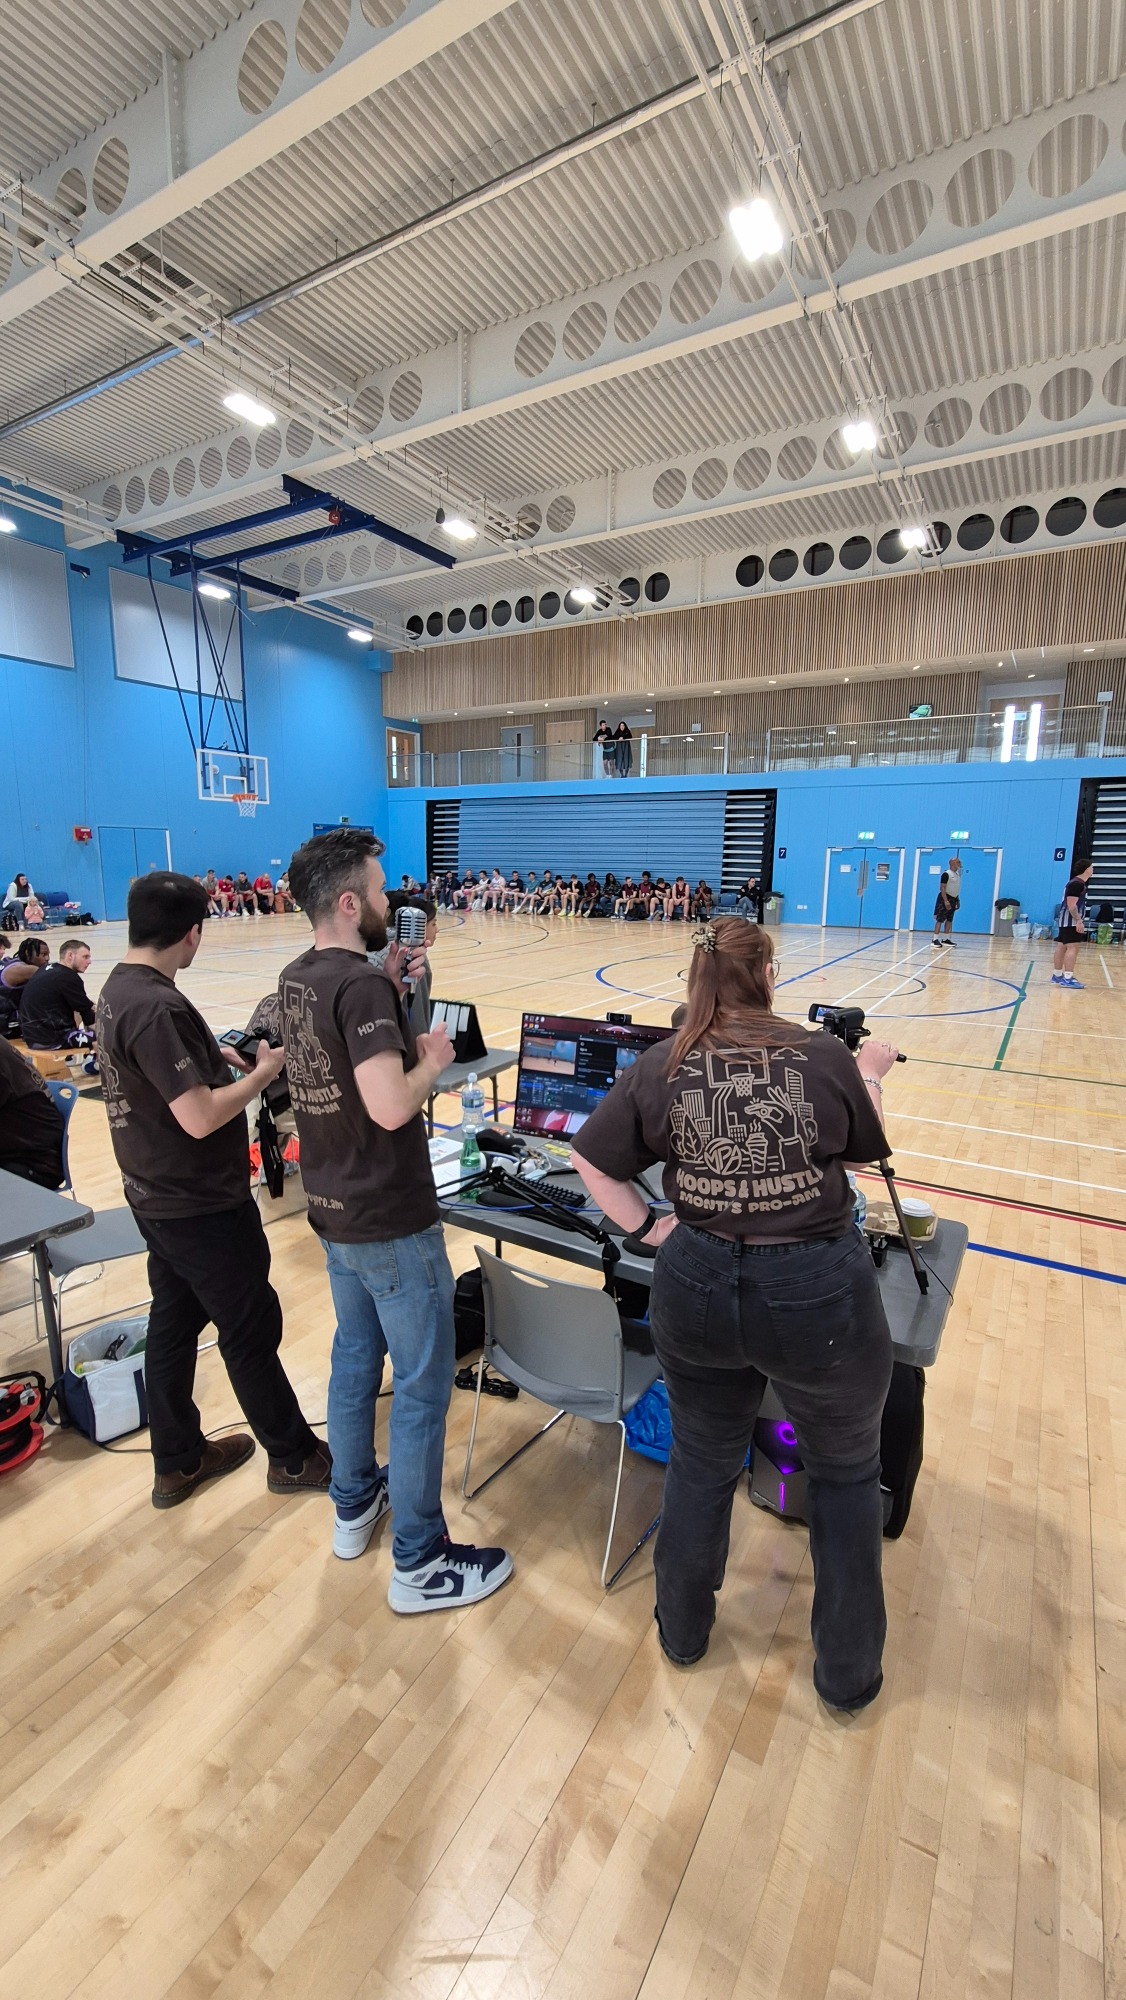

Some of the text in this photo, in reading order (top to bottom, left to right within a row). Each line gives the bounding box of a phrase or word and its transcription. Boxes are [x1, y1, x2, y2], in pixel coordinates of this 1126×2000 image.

[780, 849, 786, 857] 7
[1056, 850, 1064, 859] 6
[357, 1021, 375, 1037] HD
[676, 1168, 737, 1198] HOOPS
[738, 1180, 750, 1199] &
[748, 1187, 821, 1213] PRO-AM
